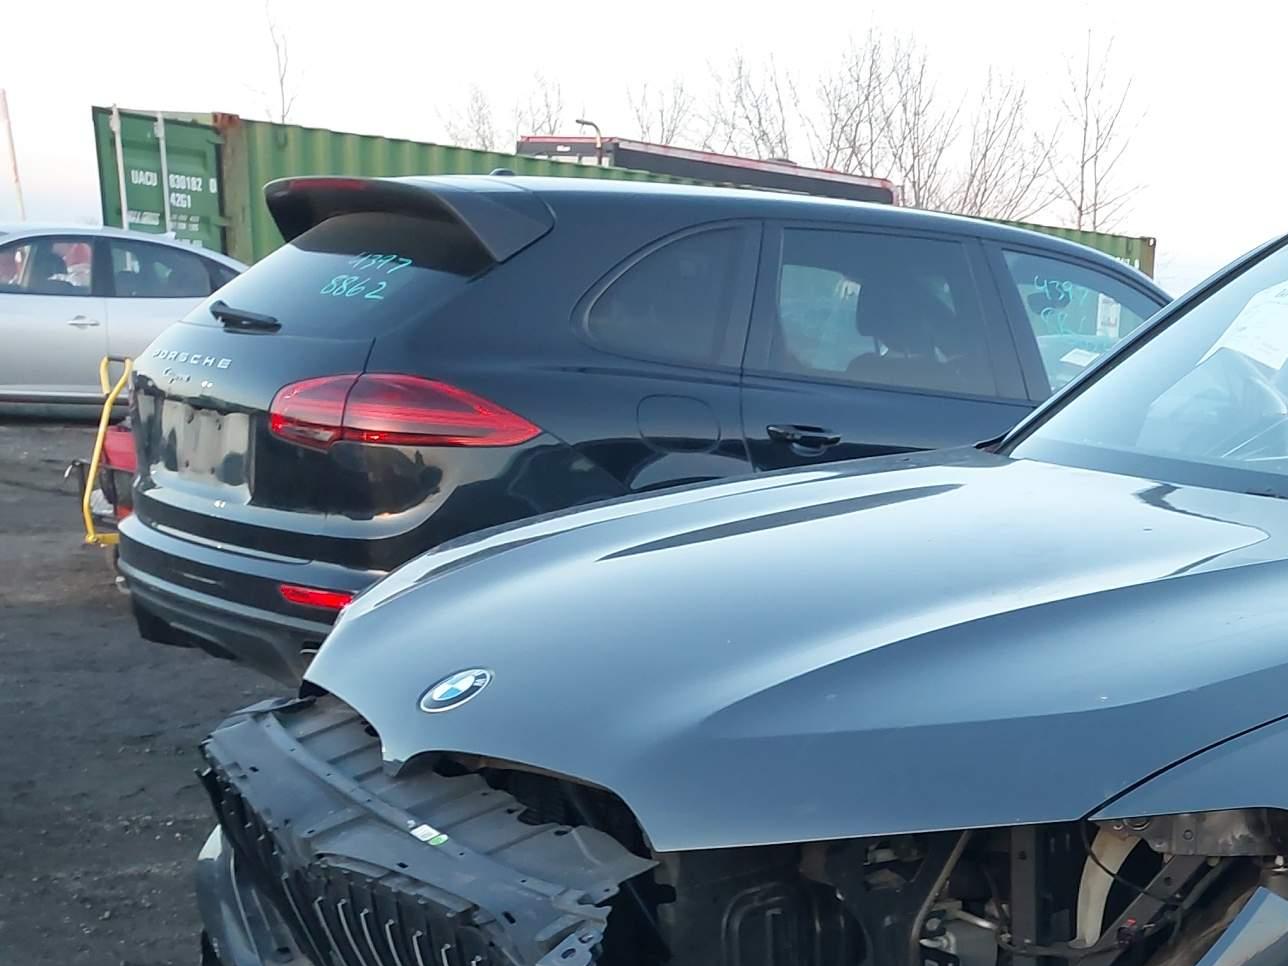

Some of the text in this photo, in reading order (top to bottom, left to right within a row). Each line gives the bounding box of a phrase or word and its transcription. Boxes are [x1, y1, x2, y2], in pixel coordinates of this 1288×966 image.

[131, 169, 158, 187] UACU
[320, 275, 386, 300] 8862
[153, 350, 233, 369] PORSCHE
